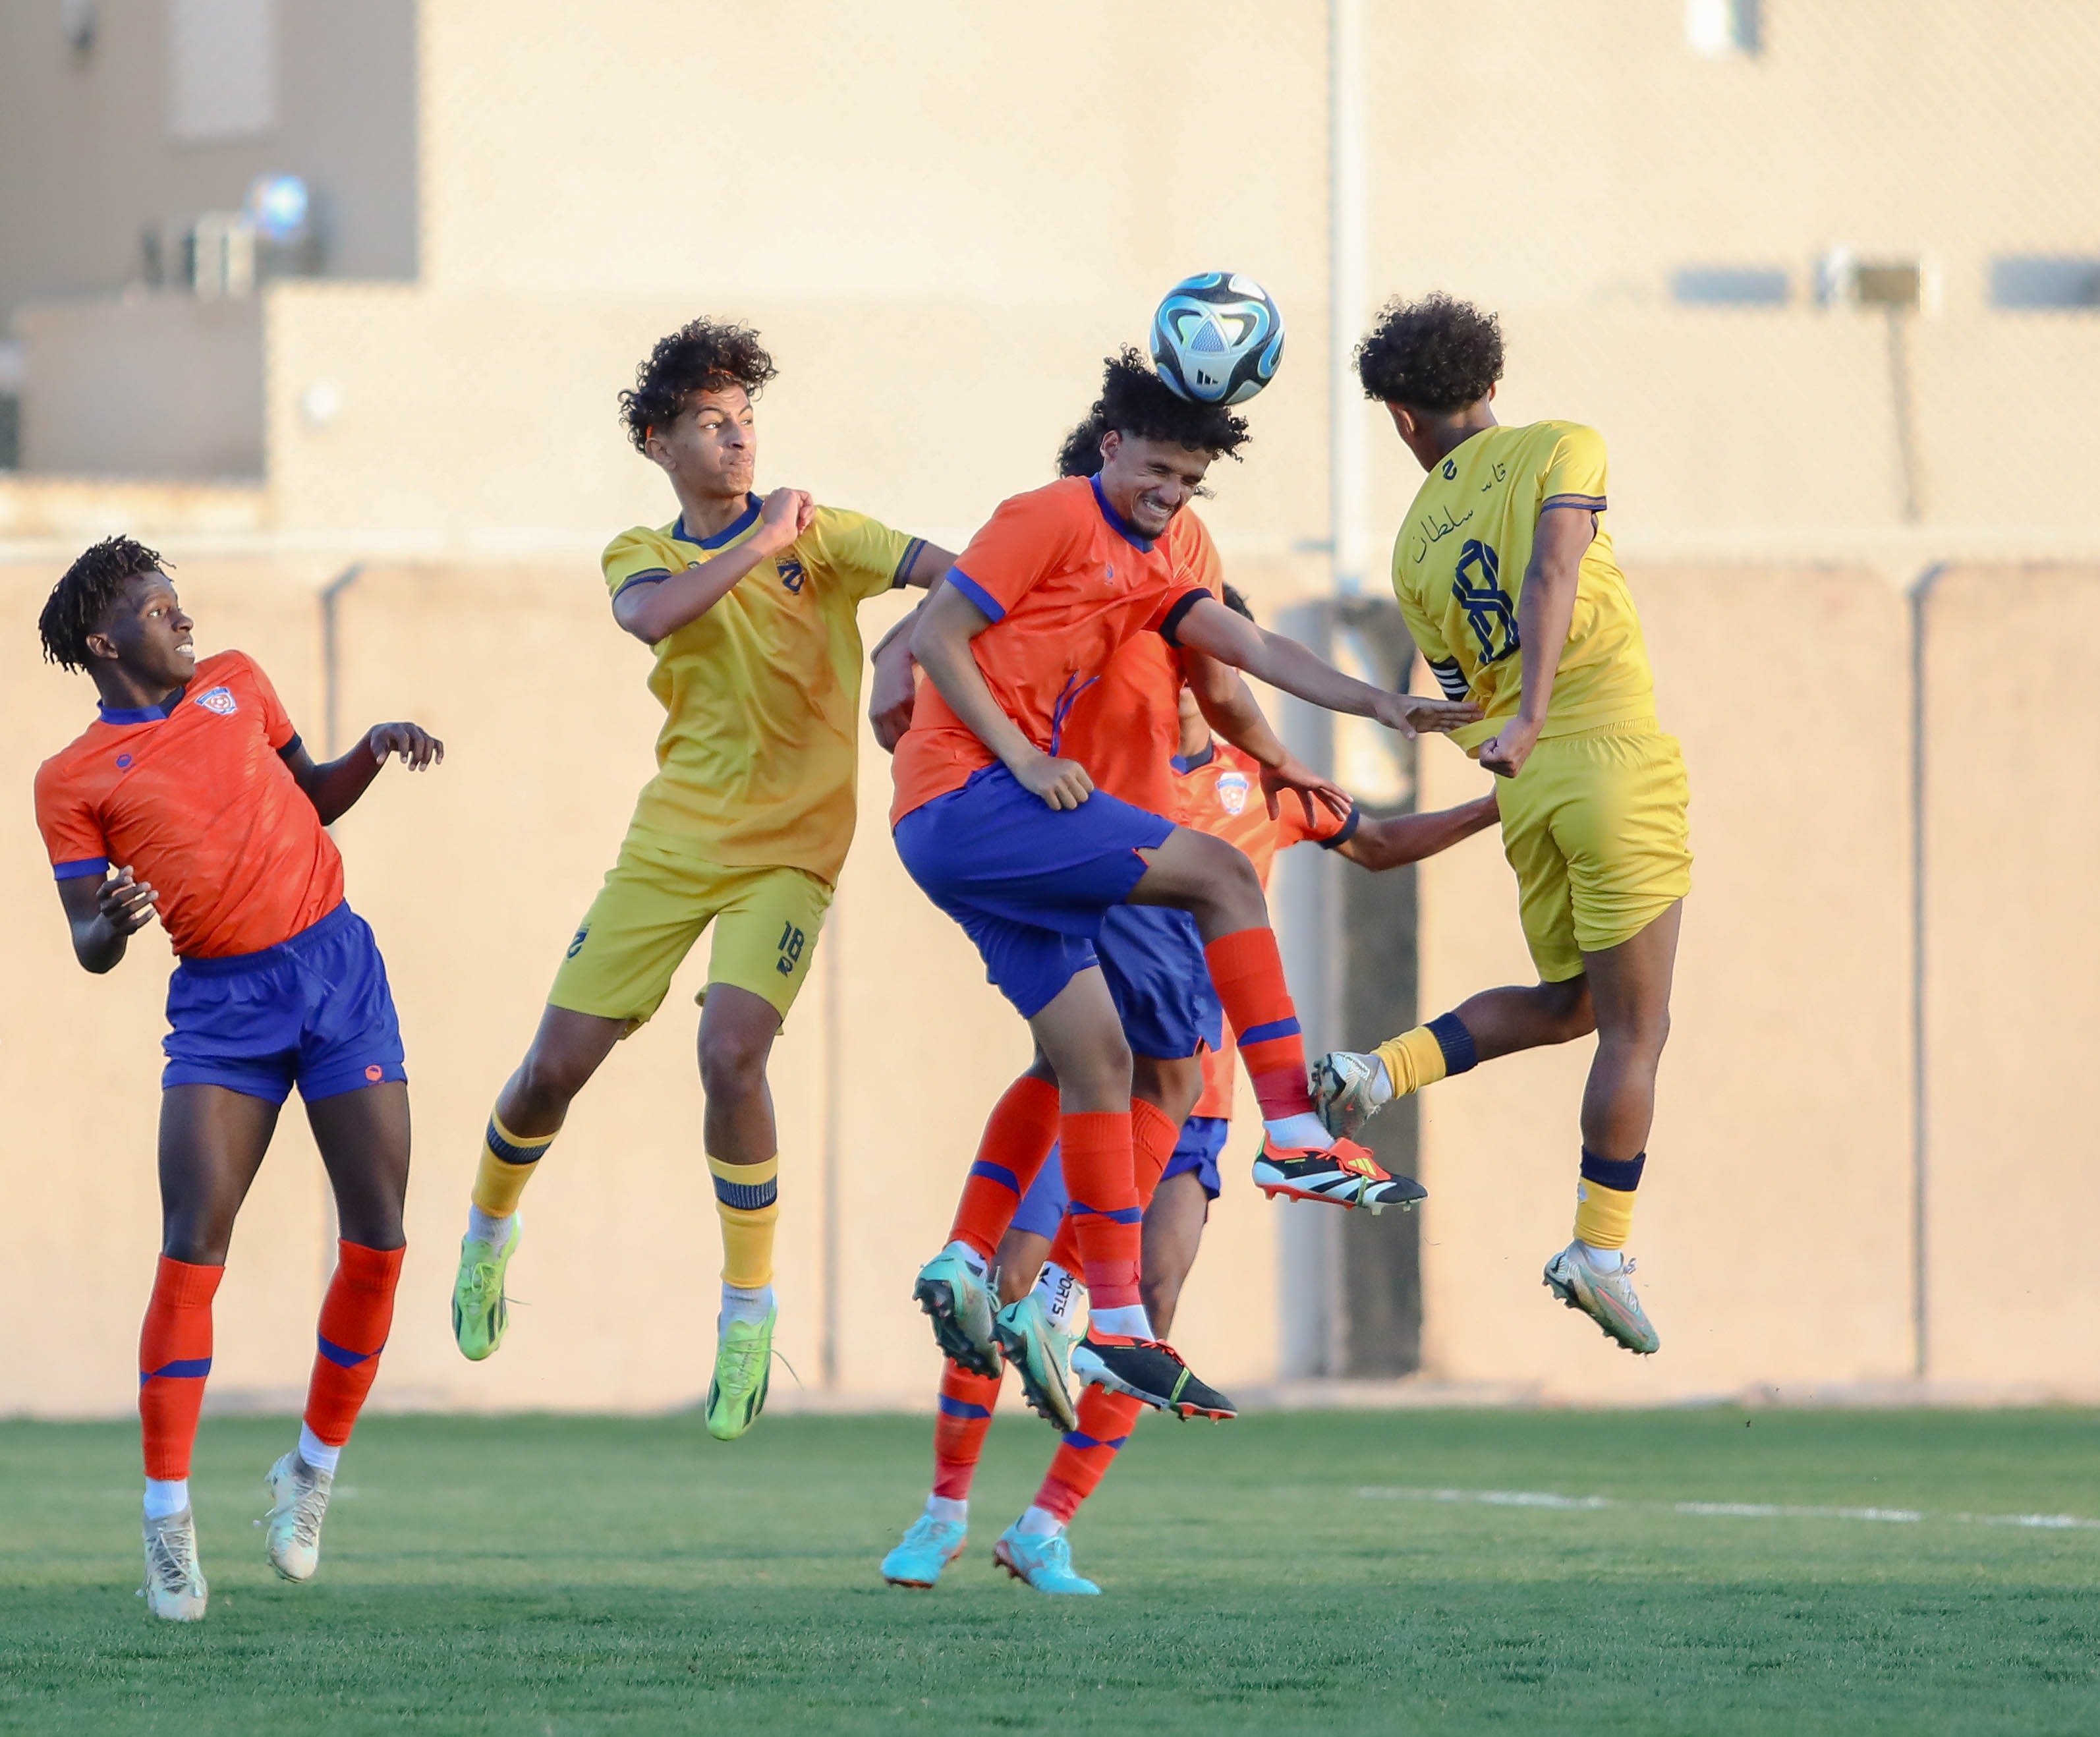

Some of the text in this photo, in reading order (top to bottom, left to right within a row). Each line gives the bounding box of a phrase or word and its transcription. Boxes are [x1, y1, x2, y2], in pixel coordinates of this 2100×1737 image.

[1412, 505, 1473, 564] سلطان
[1452, 539, 1521, 666] 8
[778, 920, 805, 963] 18
